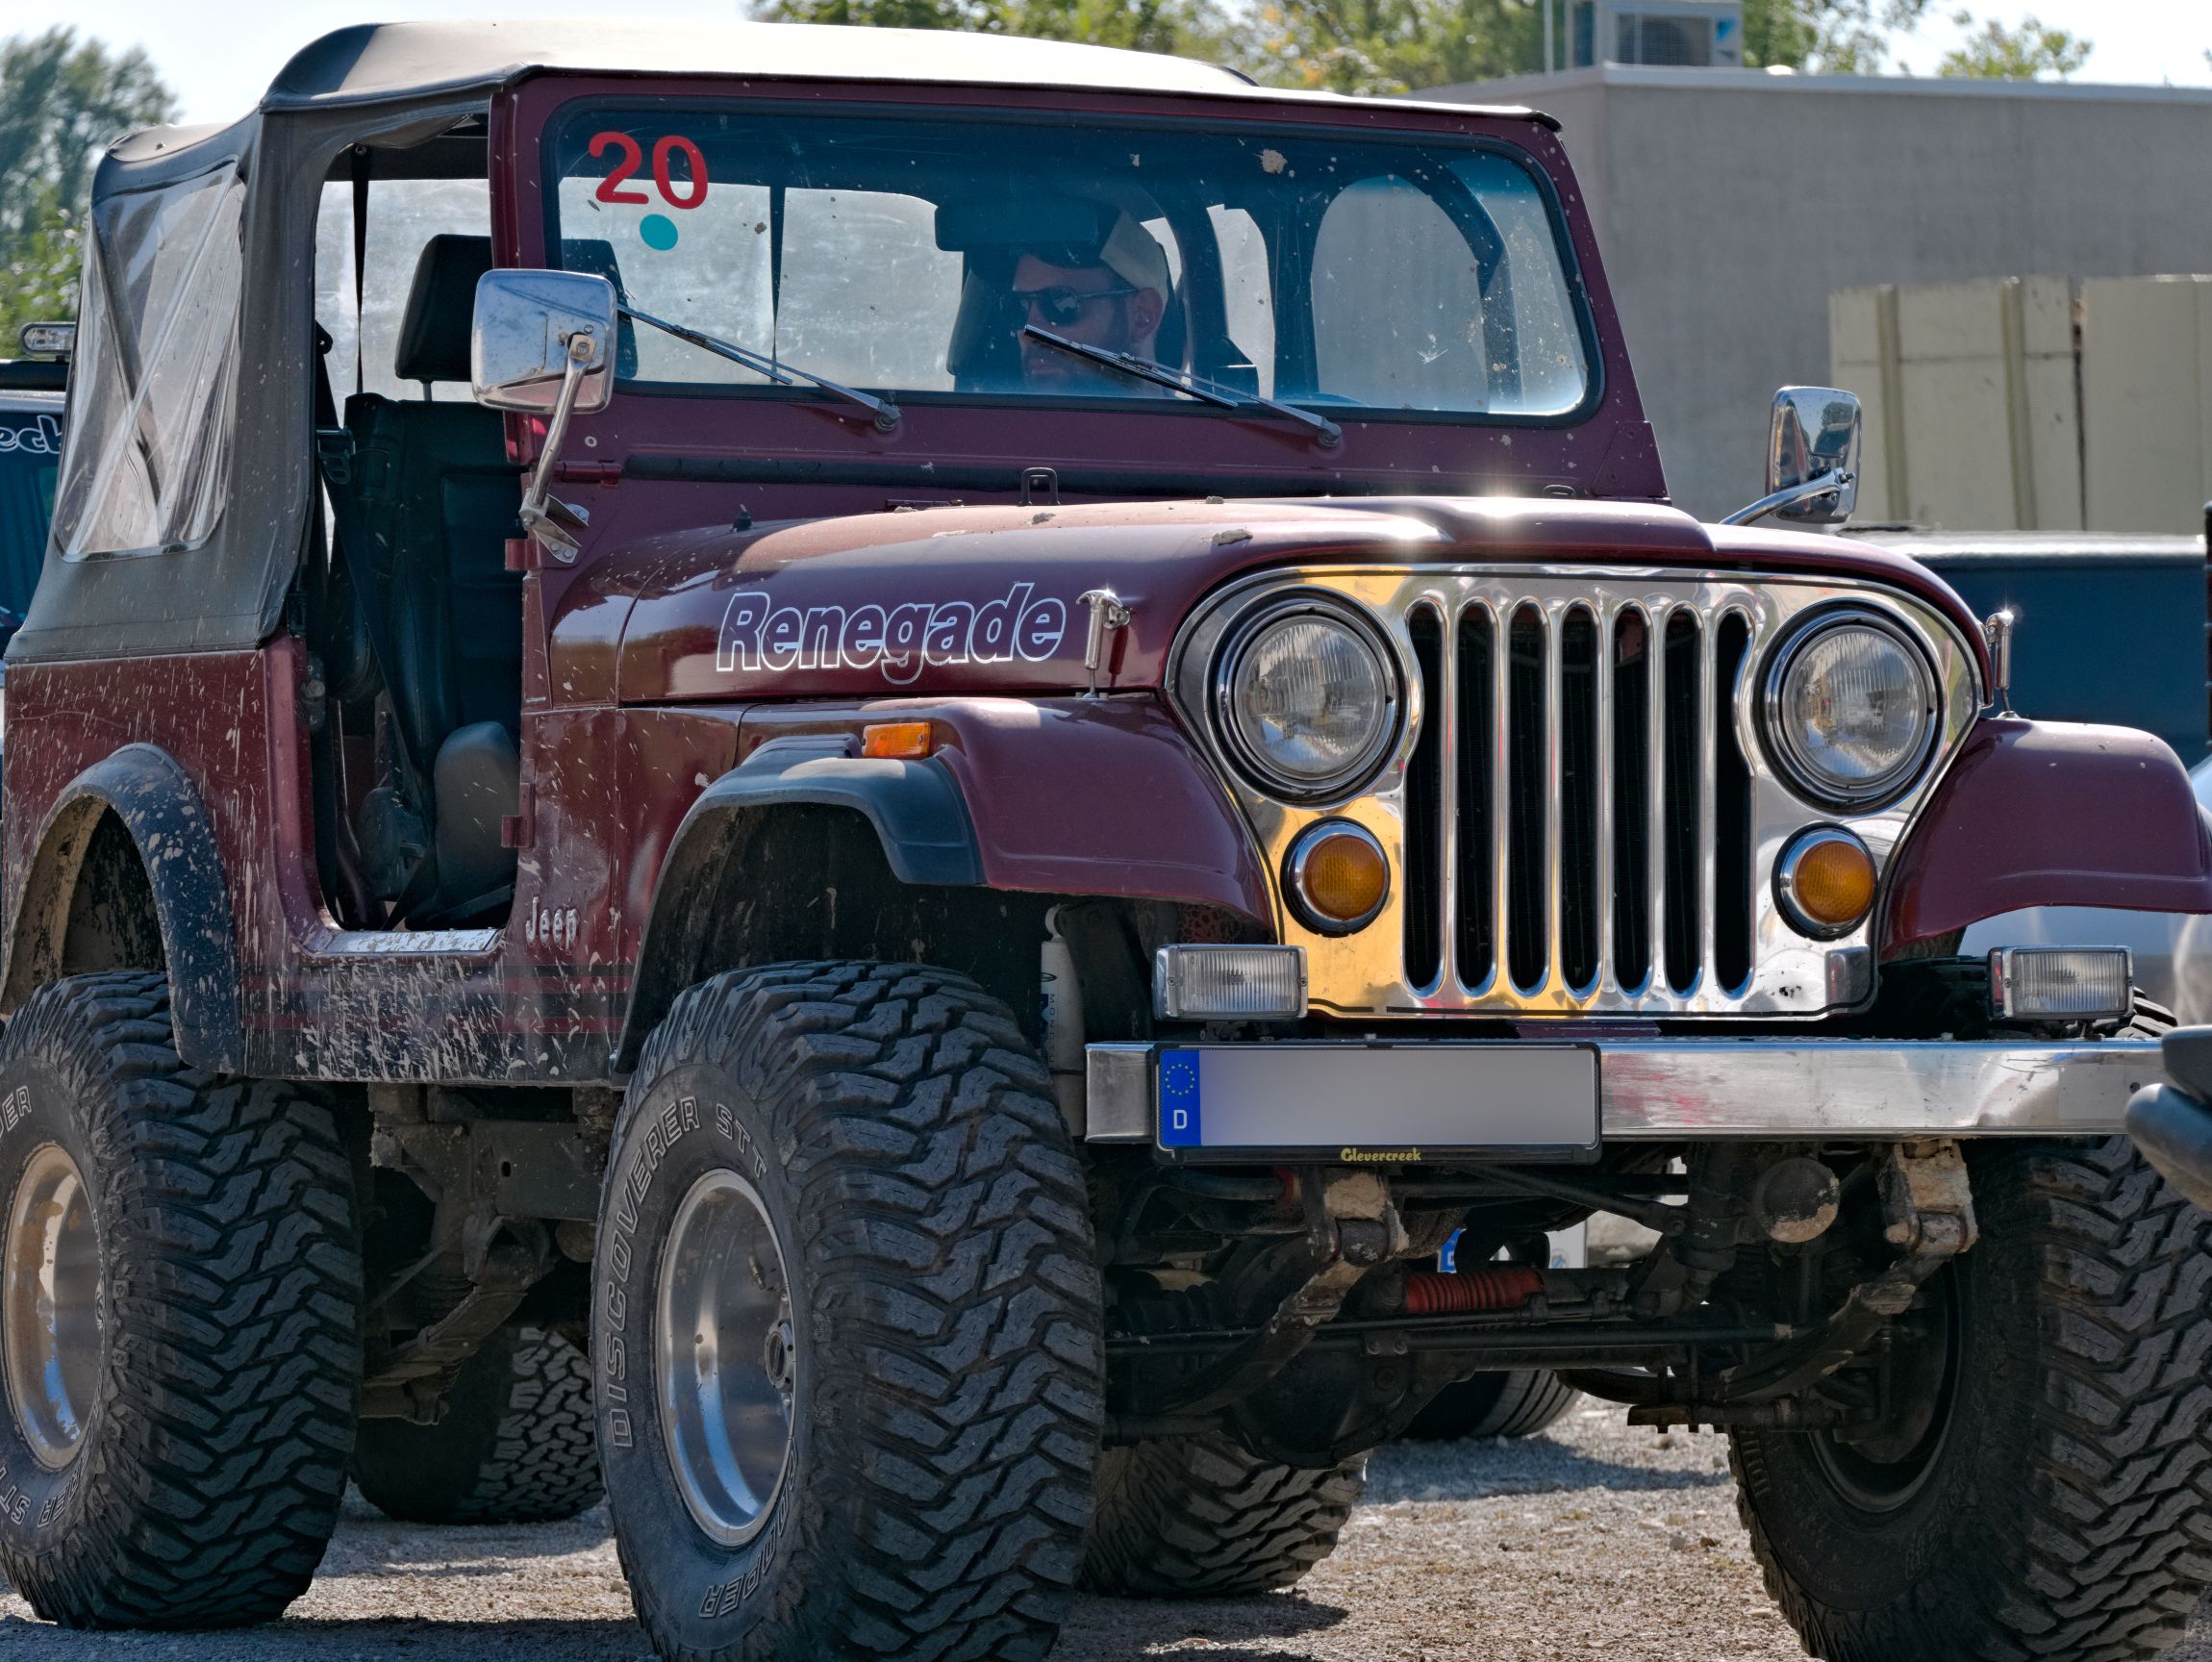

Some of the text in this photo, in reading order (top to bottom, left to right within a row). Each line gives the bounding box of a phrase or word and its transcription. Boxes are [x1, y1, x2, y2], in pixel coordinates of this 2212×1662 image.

[589, 131, 709, 210] 20
[716, 582, 1067, 685] Renegade
[525, 896, 578, 952] Jeep
[1173, 1109, 1188, 1130] D
[604, 1095, 768, 1448] DISCOVERER STT
[698, 1436, 798, 1619] COOPER
